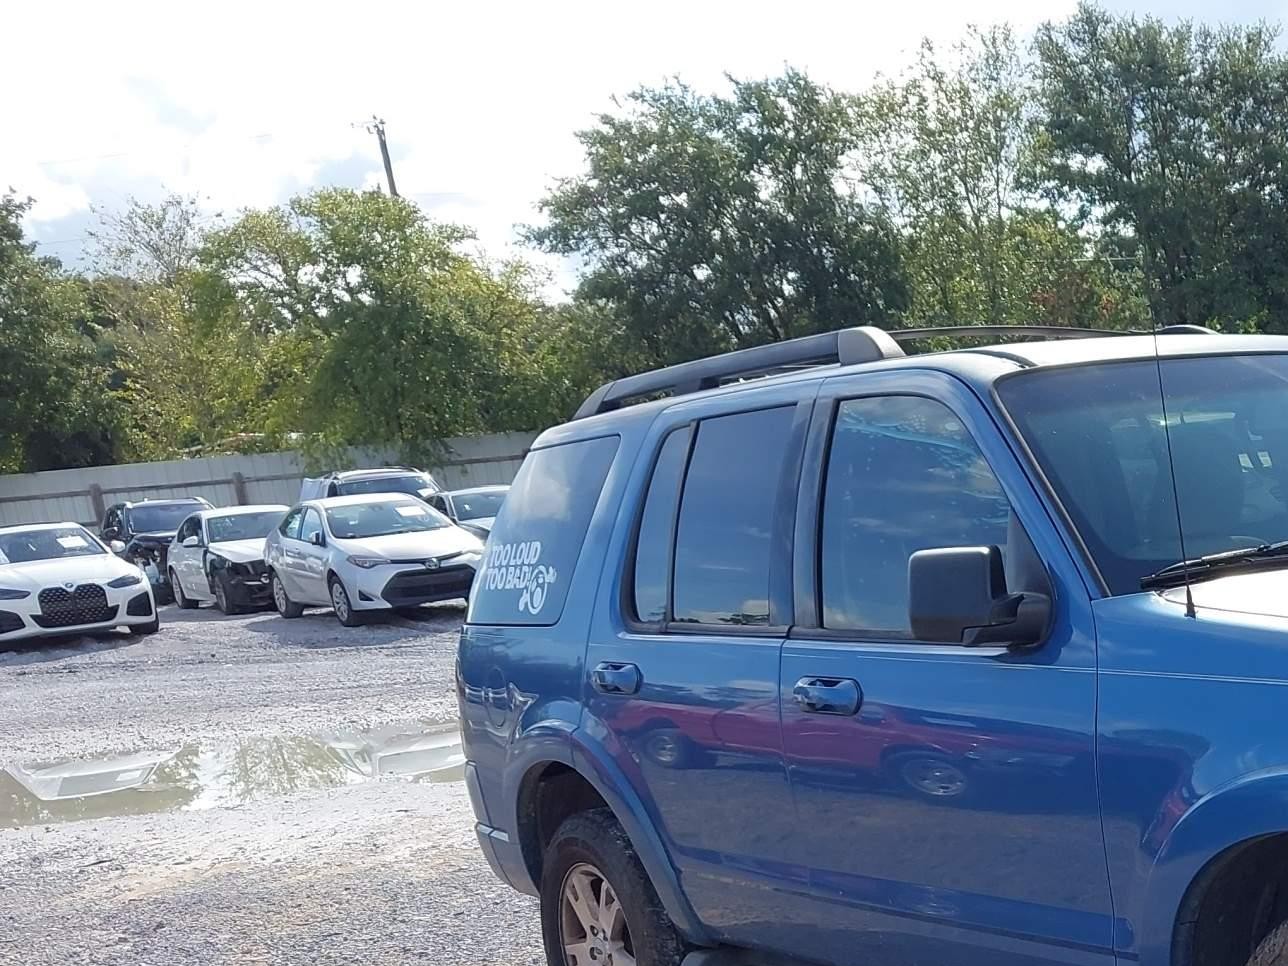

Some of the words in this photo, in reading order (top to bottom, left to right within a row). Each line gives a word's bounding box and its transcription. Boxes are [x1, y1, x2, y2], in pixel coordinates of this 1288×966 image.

[490, 543, 511, 567] TOO
[510, 541, 541, 565] LOUD
[486, 566, 506, 591] TOO
[505, 565, 532, 589] BAD!
